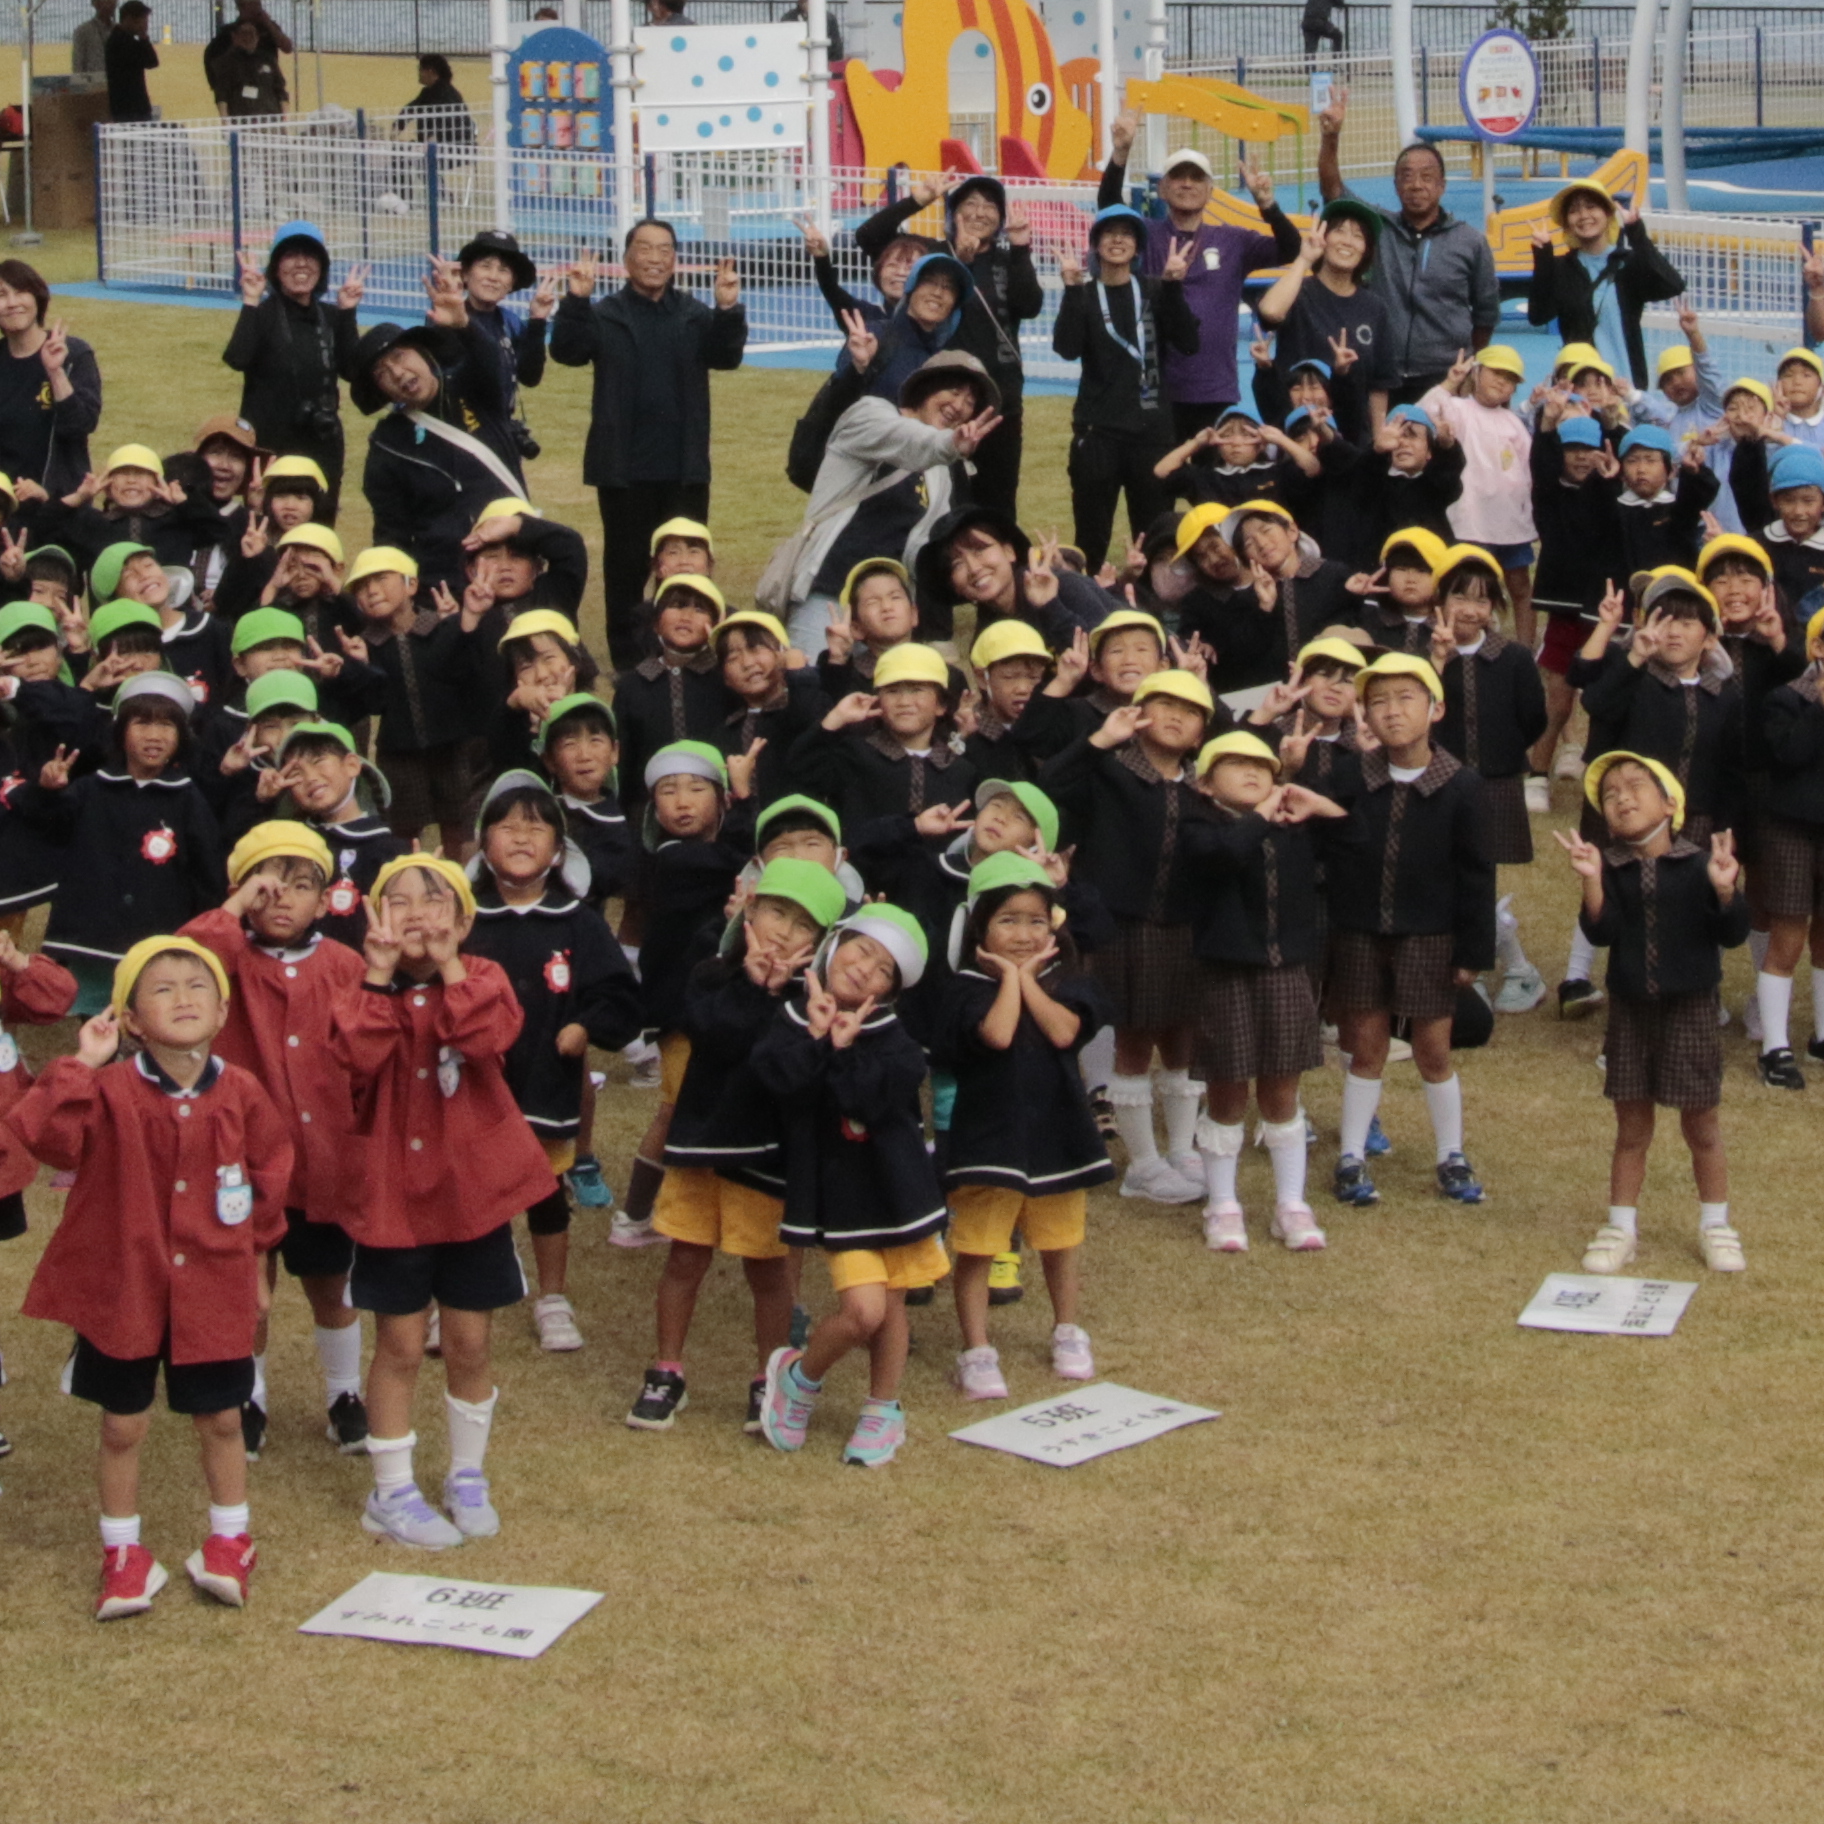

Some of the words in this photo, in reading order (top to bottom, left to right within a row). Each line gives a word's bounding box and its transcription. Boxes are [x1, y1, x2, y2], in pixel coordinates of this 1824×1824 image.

[1021, 1401, 1102, 1428] 5班
[426, 1586, 513, 1611] 6班
[339, 1608, 535, 1641] すみれこども園
